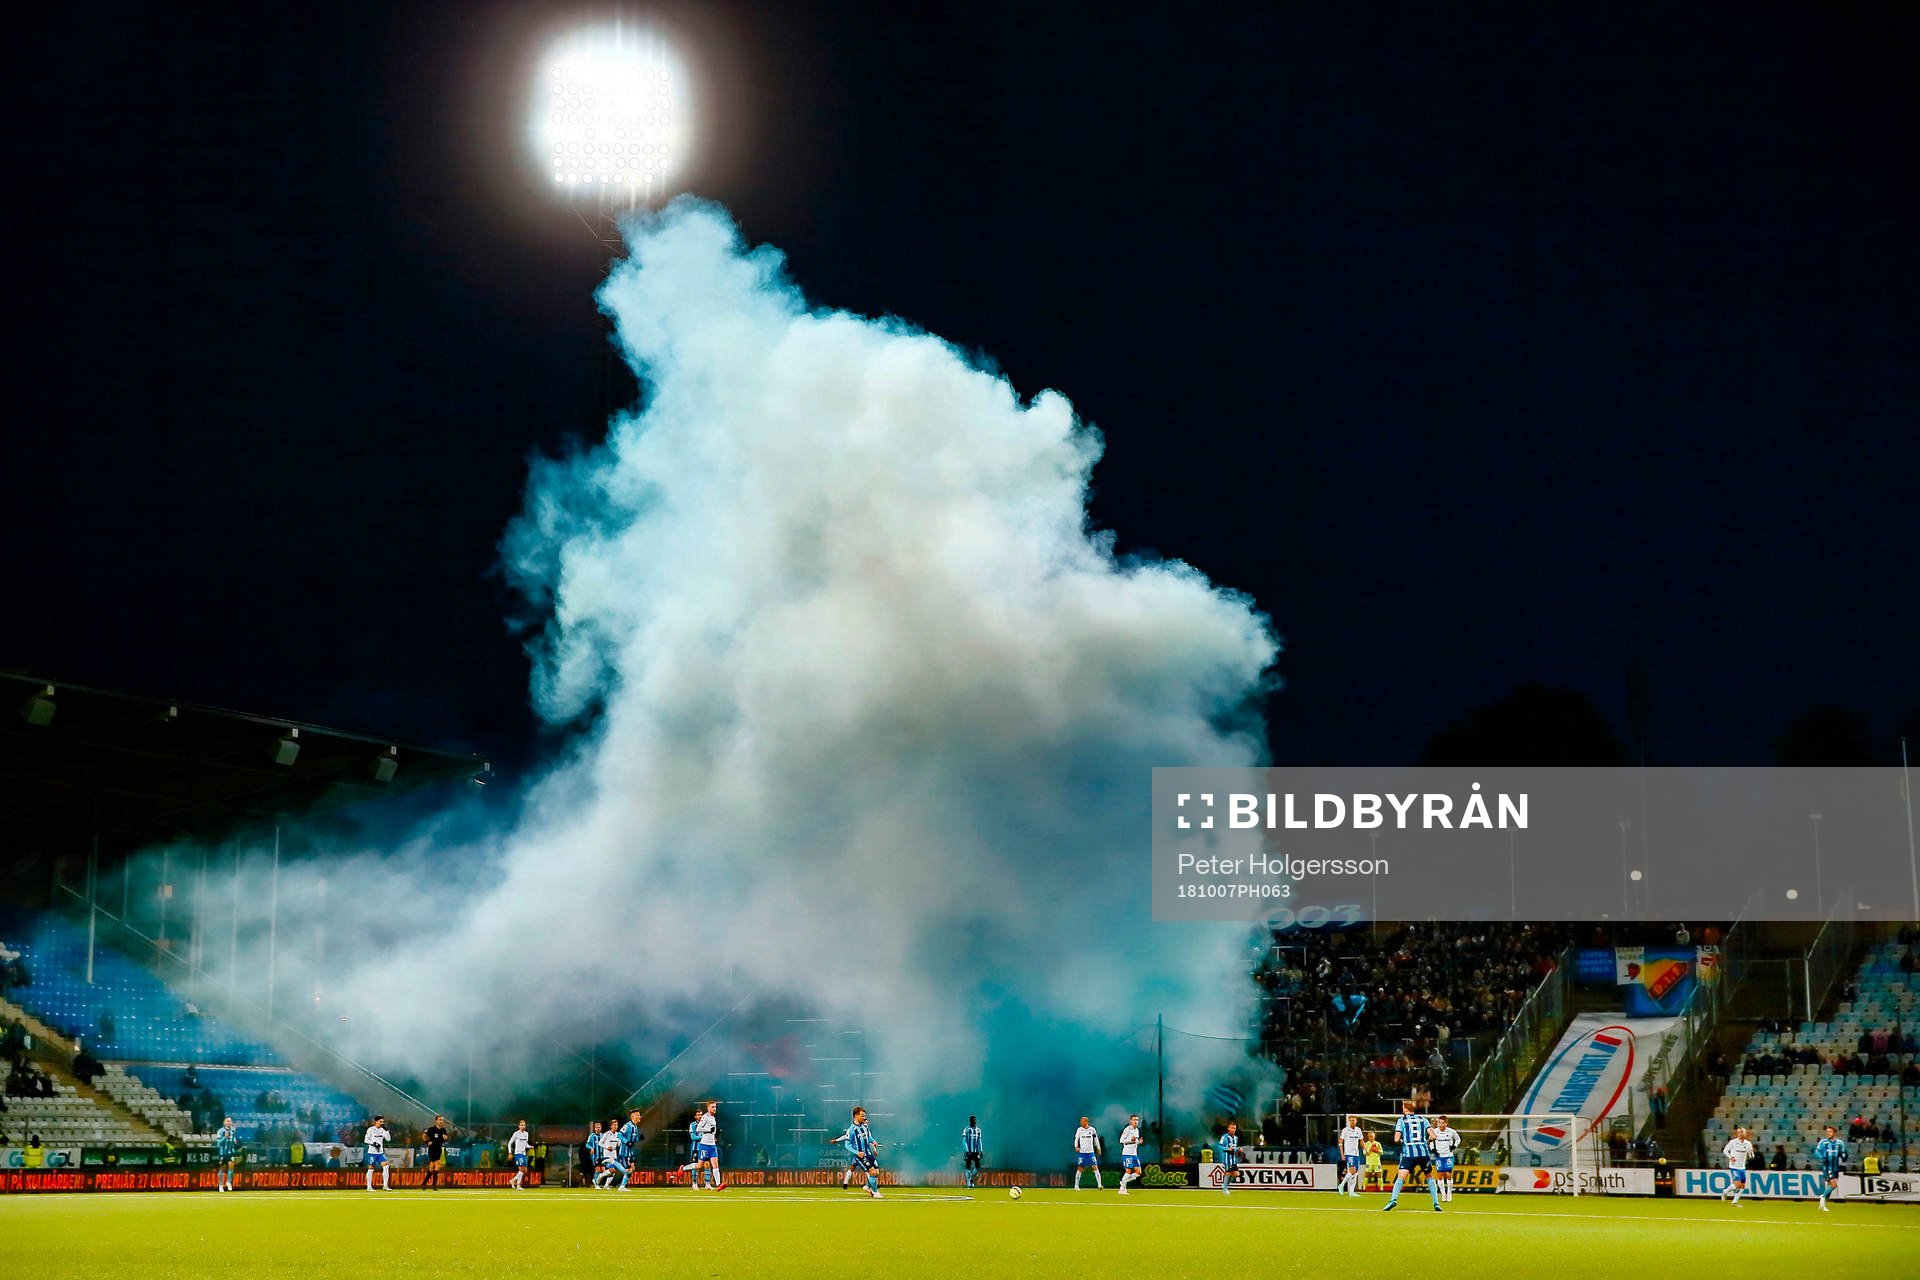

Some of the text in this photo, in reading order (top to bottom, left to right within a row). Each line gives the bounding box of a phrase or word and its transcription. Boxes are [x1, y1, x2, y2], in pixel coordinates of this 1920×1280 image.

[776, 1171, 834, 1185] HALLOWEEN
[1142, 1164, 1189, 1186] Leca
[1233, 1169, 1309, 1185] BYGMA
[1579, 1172, 1625, 1188] Smith
[1686, 1171, 1825, 1196] HOMEN
